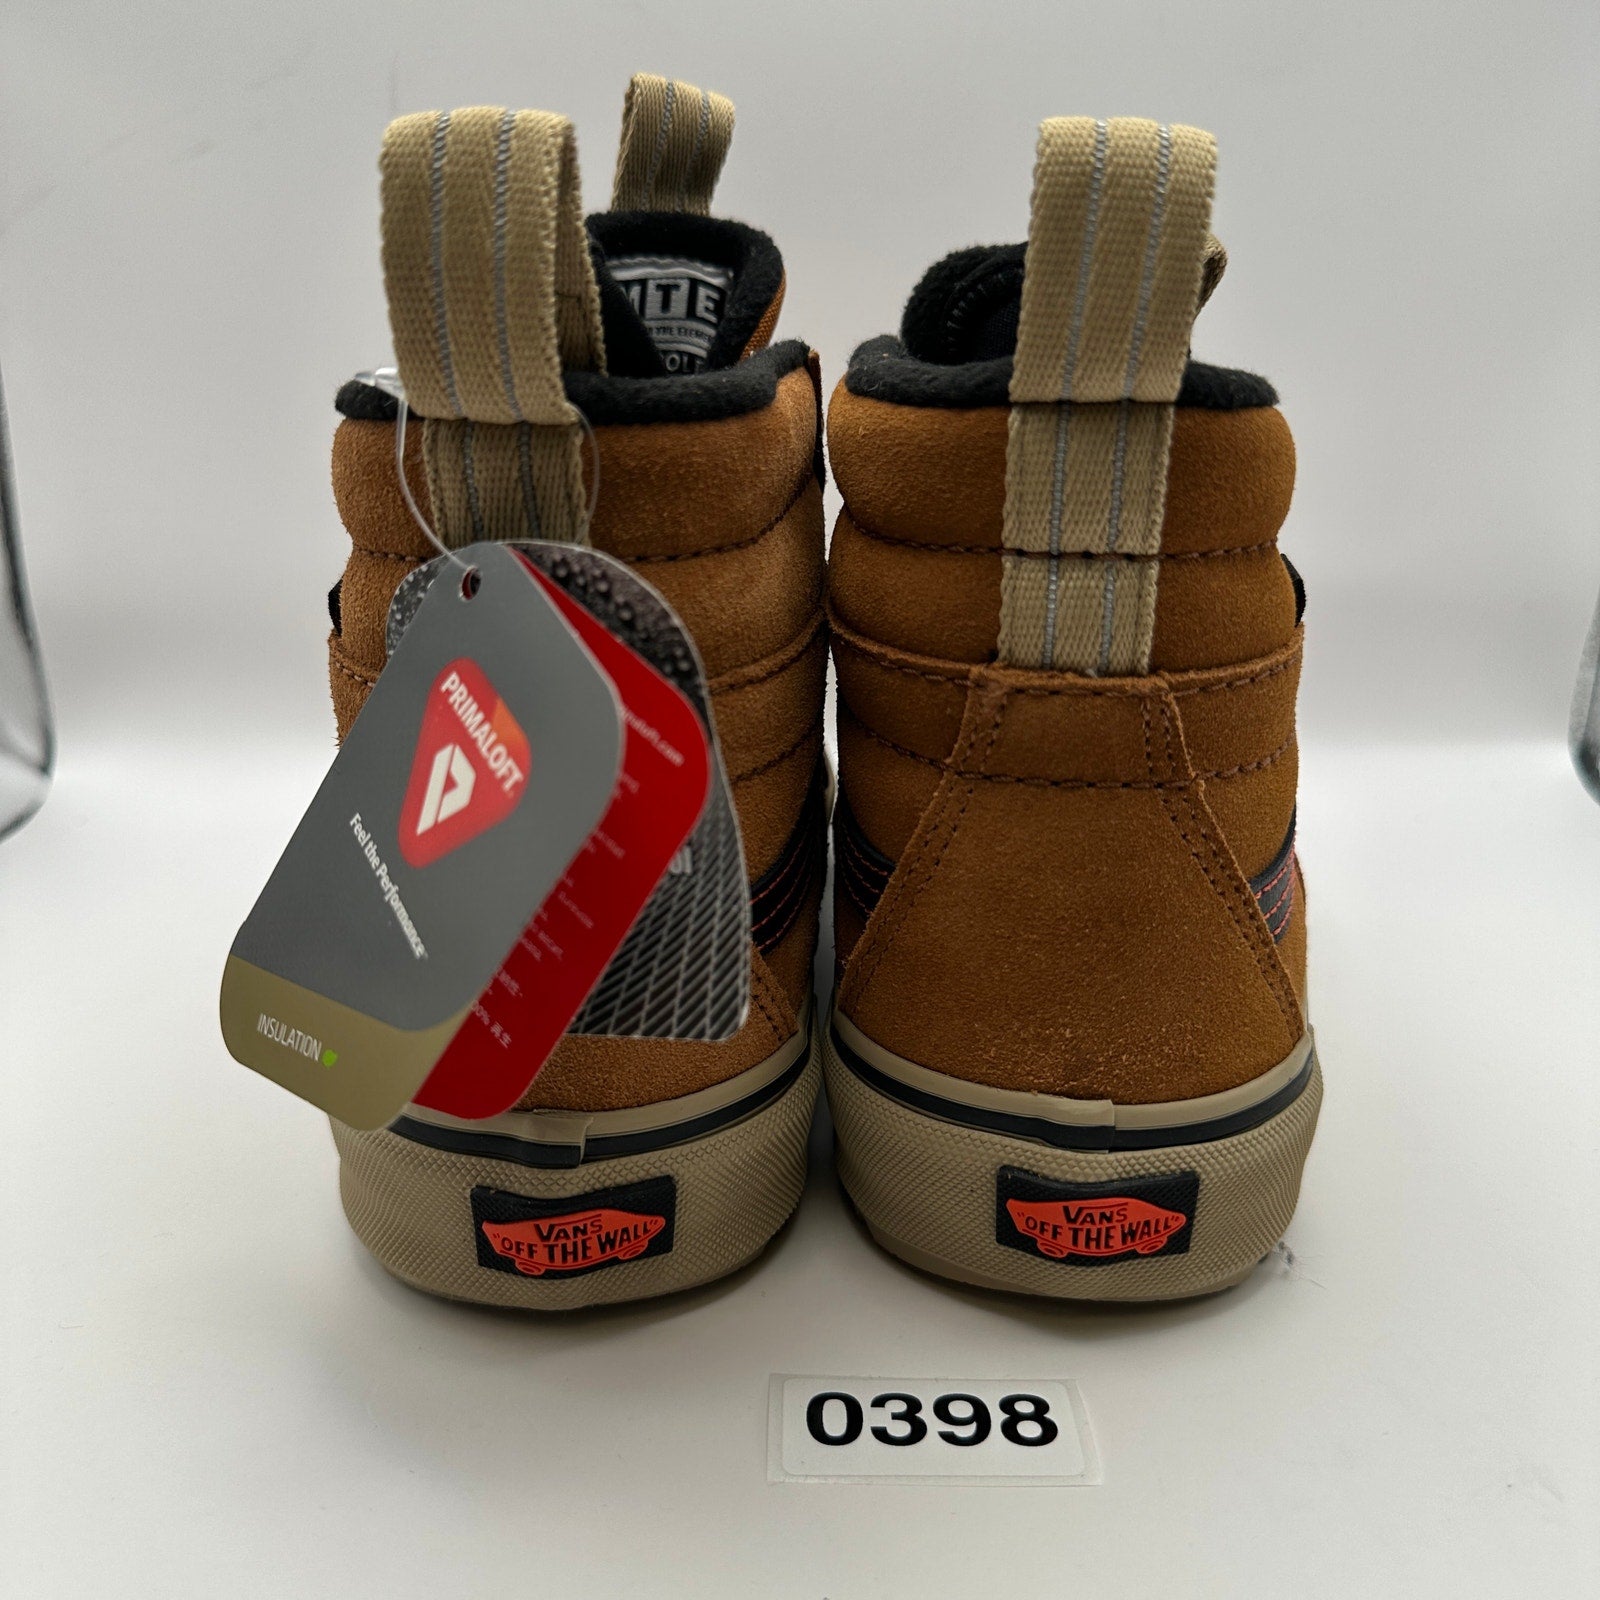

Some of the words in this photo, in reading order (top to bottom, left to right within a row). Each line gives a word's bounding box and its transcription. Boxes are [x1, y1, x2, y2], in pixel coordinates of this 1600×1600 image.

[440, 671, 524, 792] PRIMALOFT
[350, 812, 371, 847] Feel
[366, 838, 380, 870] the
[376, 863, 426, 960] Performance
[257, 1012, 322, 1062] INSULATION
[534, 1213, 603, 1242] VANS
[1062, 1202, 1129, 1226] VANS
[546, 1236, 593, 1265] THE
[1068, 1226, 1117, 1250] THE
[806, 1391, 1059, 1447] 0398
